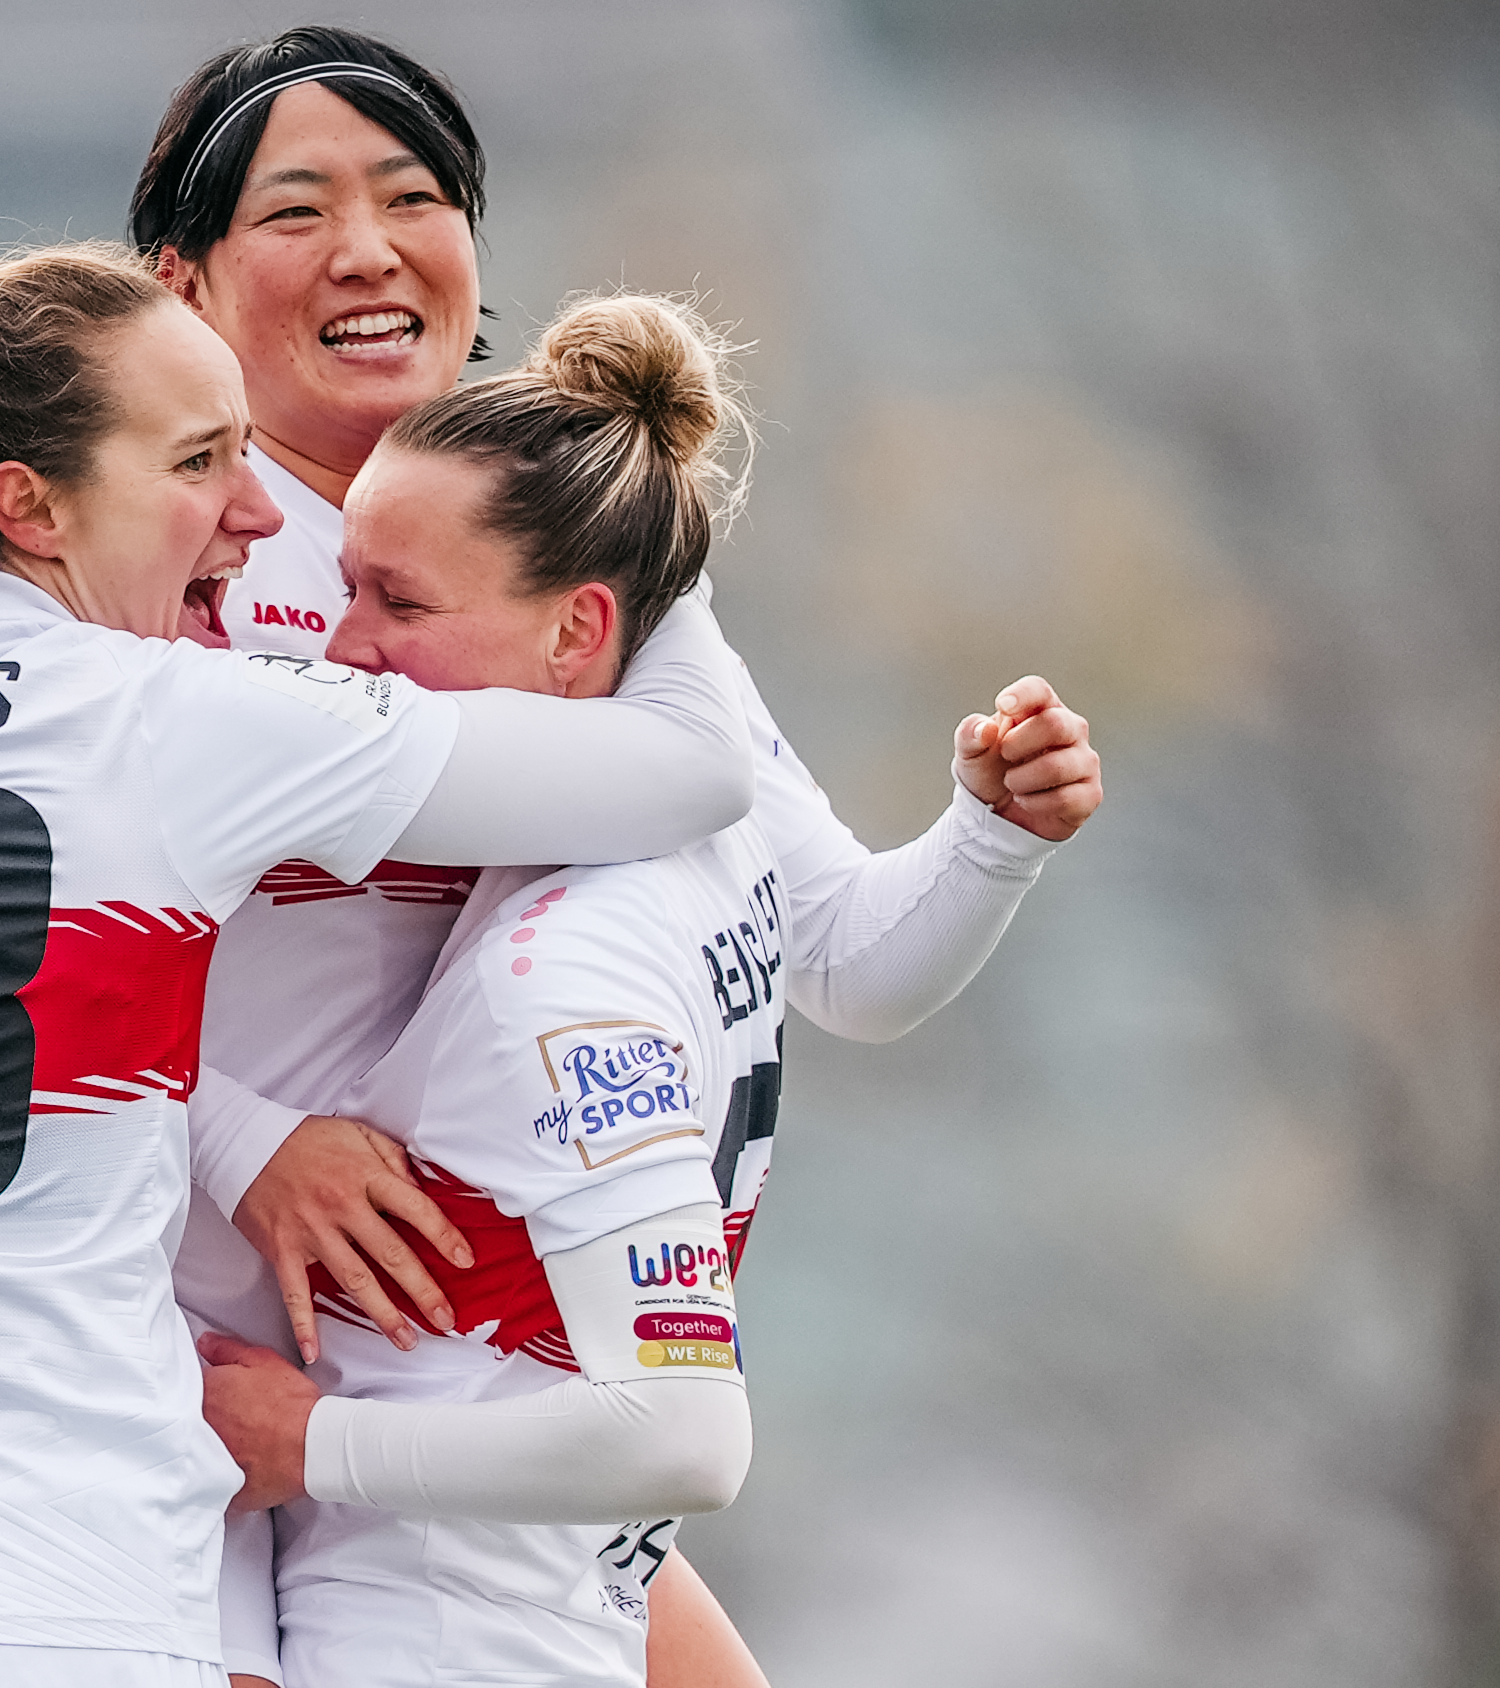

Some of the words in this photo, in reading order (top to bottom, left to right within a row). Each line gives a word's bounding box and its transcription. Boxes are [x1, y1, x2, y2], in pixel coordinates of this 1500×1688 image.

[252, 602, 327, 633] JAKO
[563, 1039, 676, 1104] Ritter
[533, 1100, 573, 1145] my
[581, 1082, 690, 1135] SPORT
[651, 1318, 723, 1337] Together
[666, 1345, 697, 1361] WE
[701, 1346, 730, 1364] Rise
